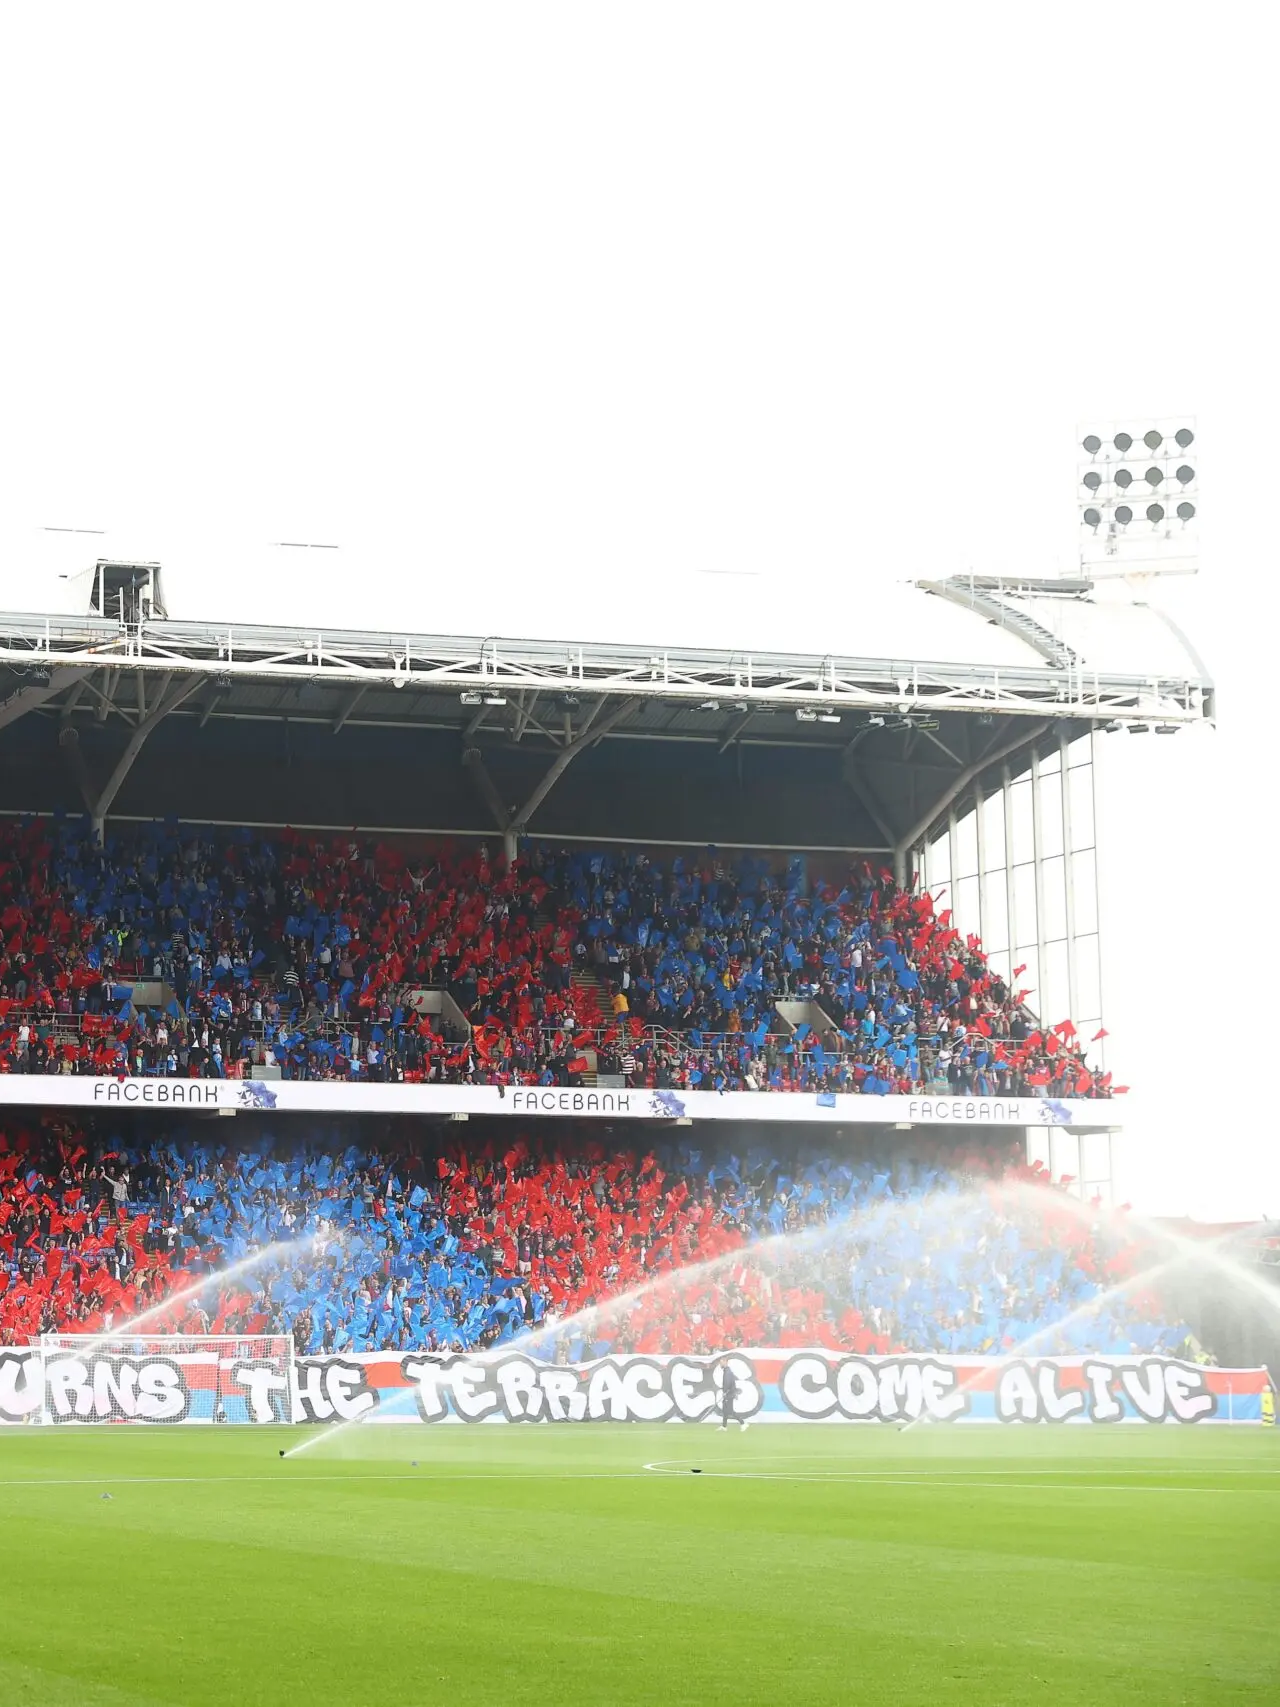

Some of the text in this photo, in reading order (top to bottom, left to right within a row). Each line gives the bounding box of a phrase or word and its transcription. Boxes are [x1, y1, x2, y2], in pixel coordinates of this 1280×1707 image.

[94, 1083, 218, 1102] FACEBANK
[513, 1092, 630, 1111] FACEBANK
[909, 1101, 1020, 1119] FACEBANK
[233, 1360, 381, 1422] THE
[404, 1357, 759, 1421] TERRACES
[781, 1358, 968, 1420] COME
[997, 1361, 1214, 1421] ALIVE
